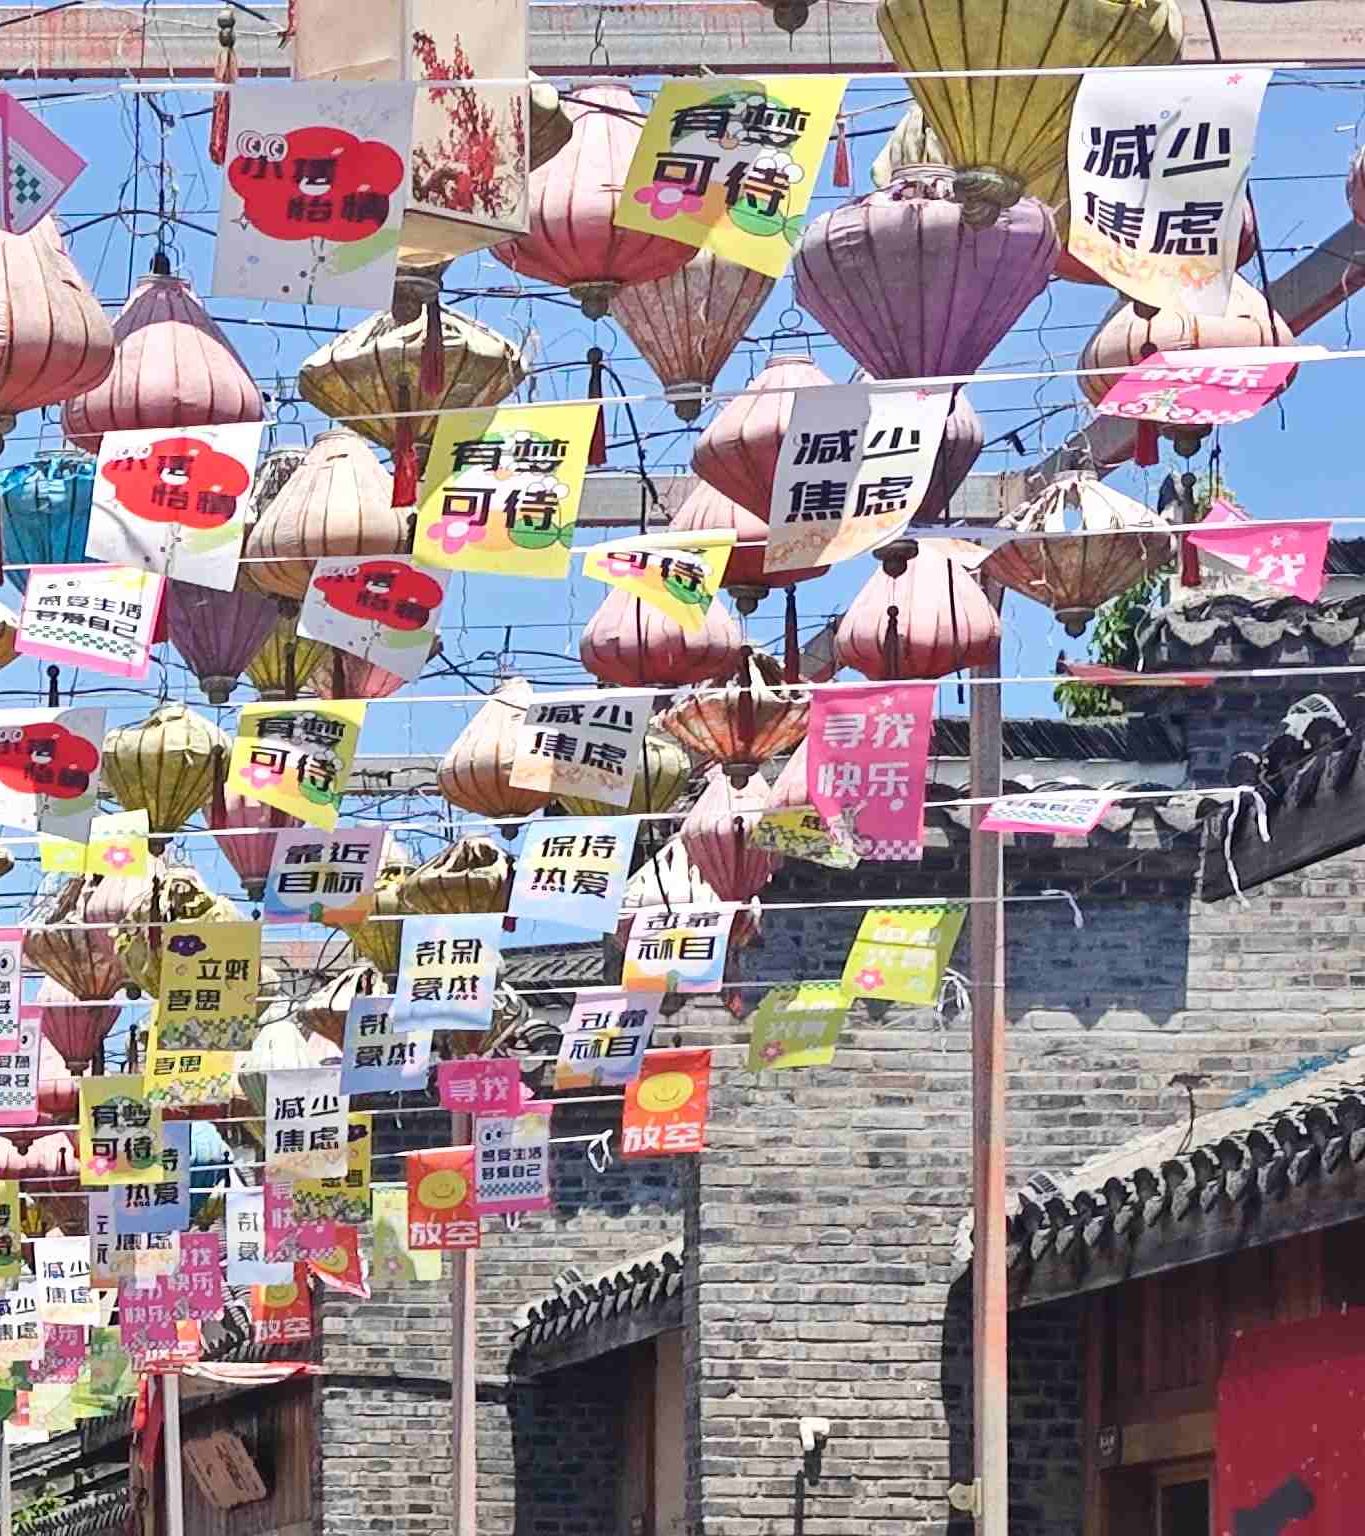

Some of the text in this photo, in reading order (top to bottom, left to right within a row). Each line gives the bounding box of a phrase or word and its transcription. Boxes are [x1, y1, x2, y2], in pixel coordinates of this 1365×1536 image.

[672, 103, 809, 145] 有梦
[1085, 122, 1231, 180] 减少
[652, 153, 791, 219] 可待
[1084, 190, 1223, 257] 焦虑
[453, 440, 569, 474] 有梦
[795, 426, 920, 466] 减少
[442, 486, 558, 532] 可待
[787, 476, 912, 522] 焦虑
[37, 596, 142, 619] 感受生活
[36, 609, 138, 639] 多爱自己
[257, 716, 347, 745] 有梦
[535, 705, 635, 733] 减少
[824, 712, 914, 747] 寻找
[526, 731, 627, 775] 焦虑
[249, 746, 336, 792] 可待
[816, 761, 910, 799] 快乐
[285, 842, 369, 867] 靠近
[541, 836, 613, 859] 保持
[277, 870, 363, 894] 目标
[531, 864, 608, 898] 热爱
[448, 1075, 508, 1101] 寻找
[92, 1105, 149, 1128] 有梦
[274, 1095, 338, 1119] 减少
[91, 1137, 153, 1162] 可待
[274, 1126, 339, 1152] 焦虑
[622, 1122, 701, 1152] 放空
[481, 1146, 542, 1162] 感受生活
[126, 1184, 179, 1207] 热爱
[409, 1220, 479, 1248] 放空
